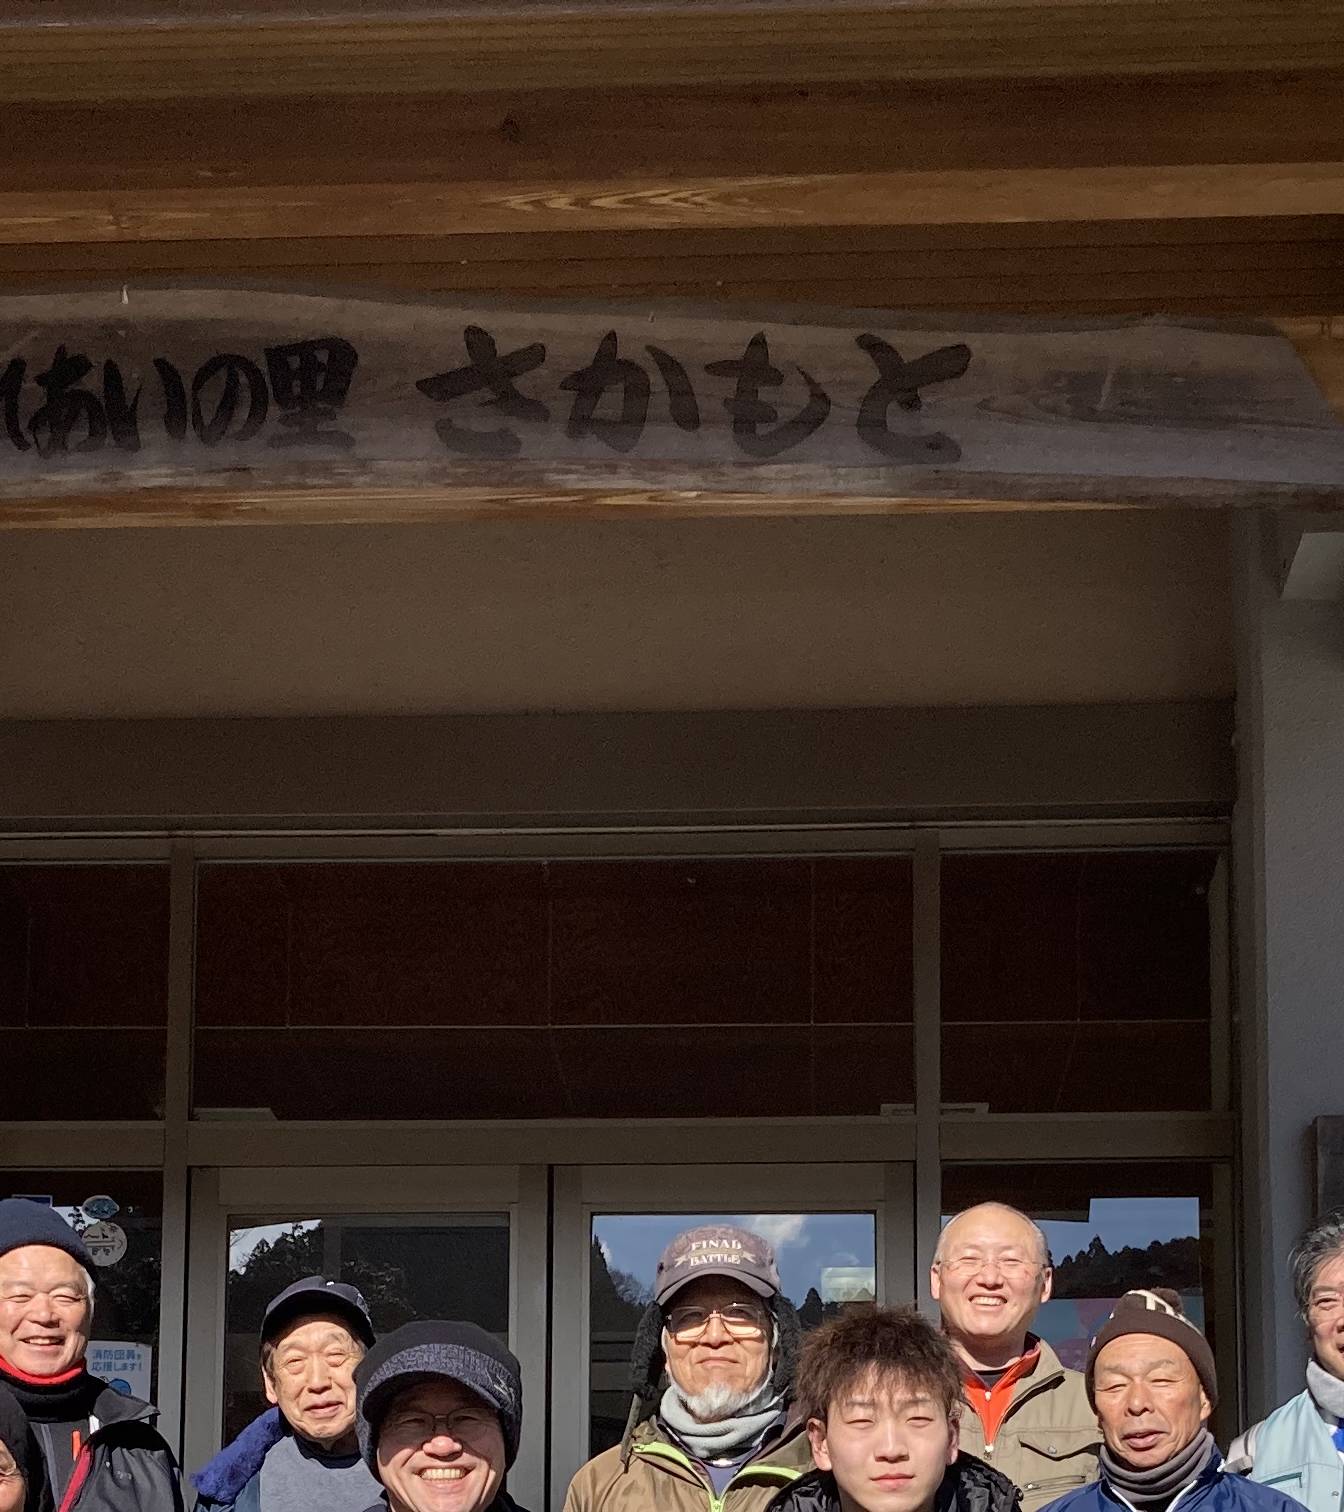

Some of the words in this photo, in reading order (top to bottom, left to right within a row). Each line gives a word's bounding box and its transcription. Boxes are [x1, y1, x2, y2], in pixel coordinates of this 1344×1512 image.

[416, 323, 973, 466] さかもと
[690, 1253, 741, 1267] BATTLE
